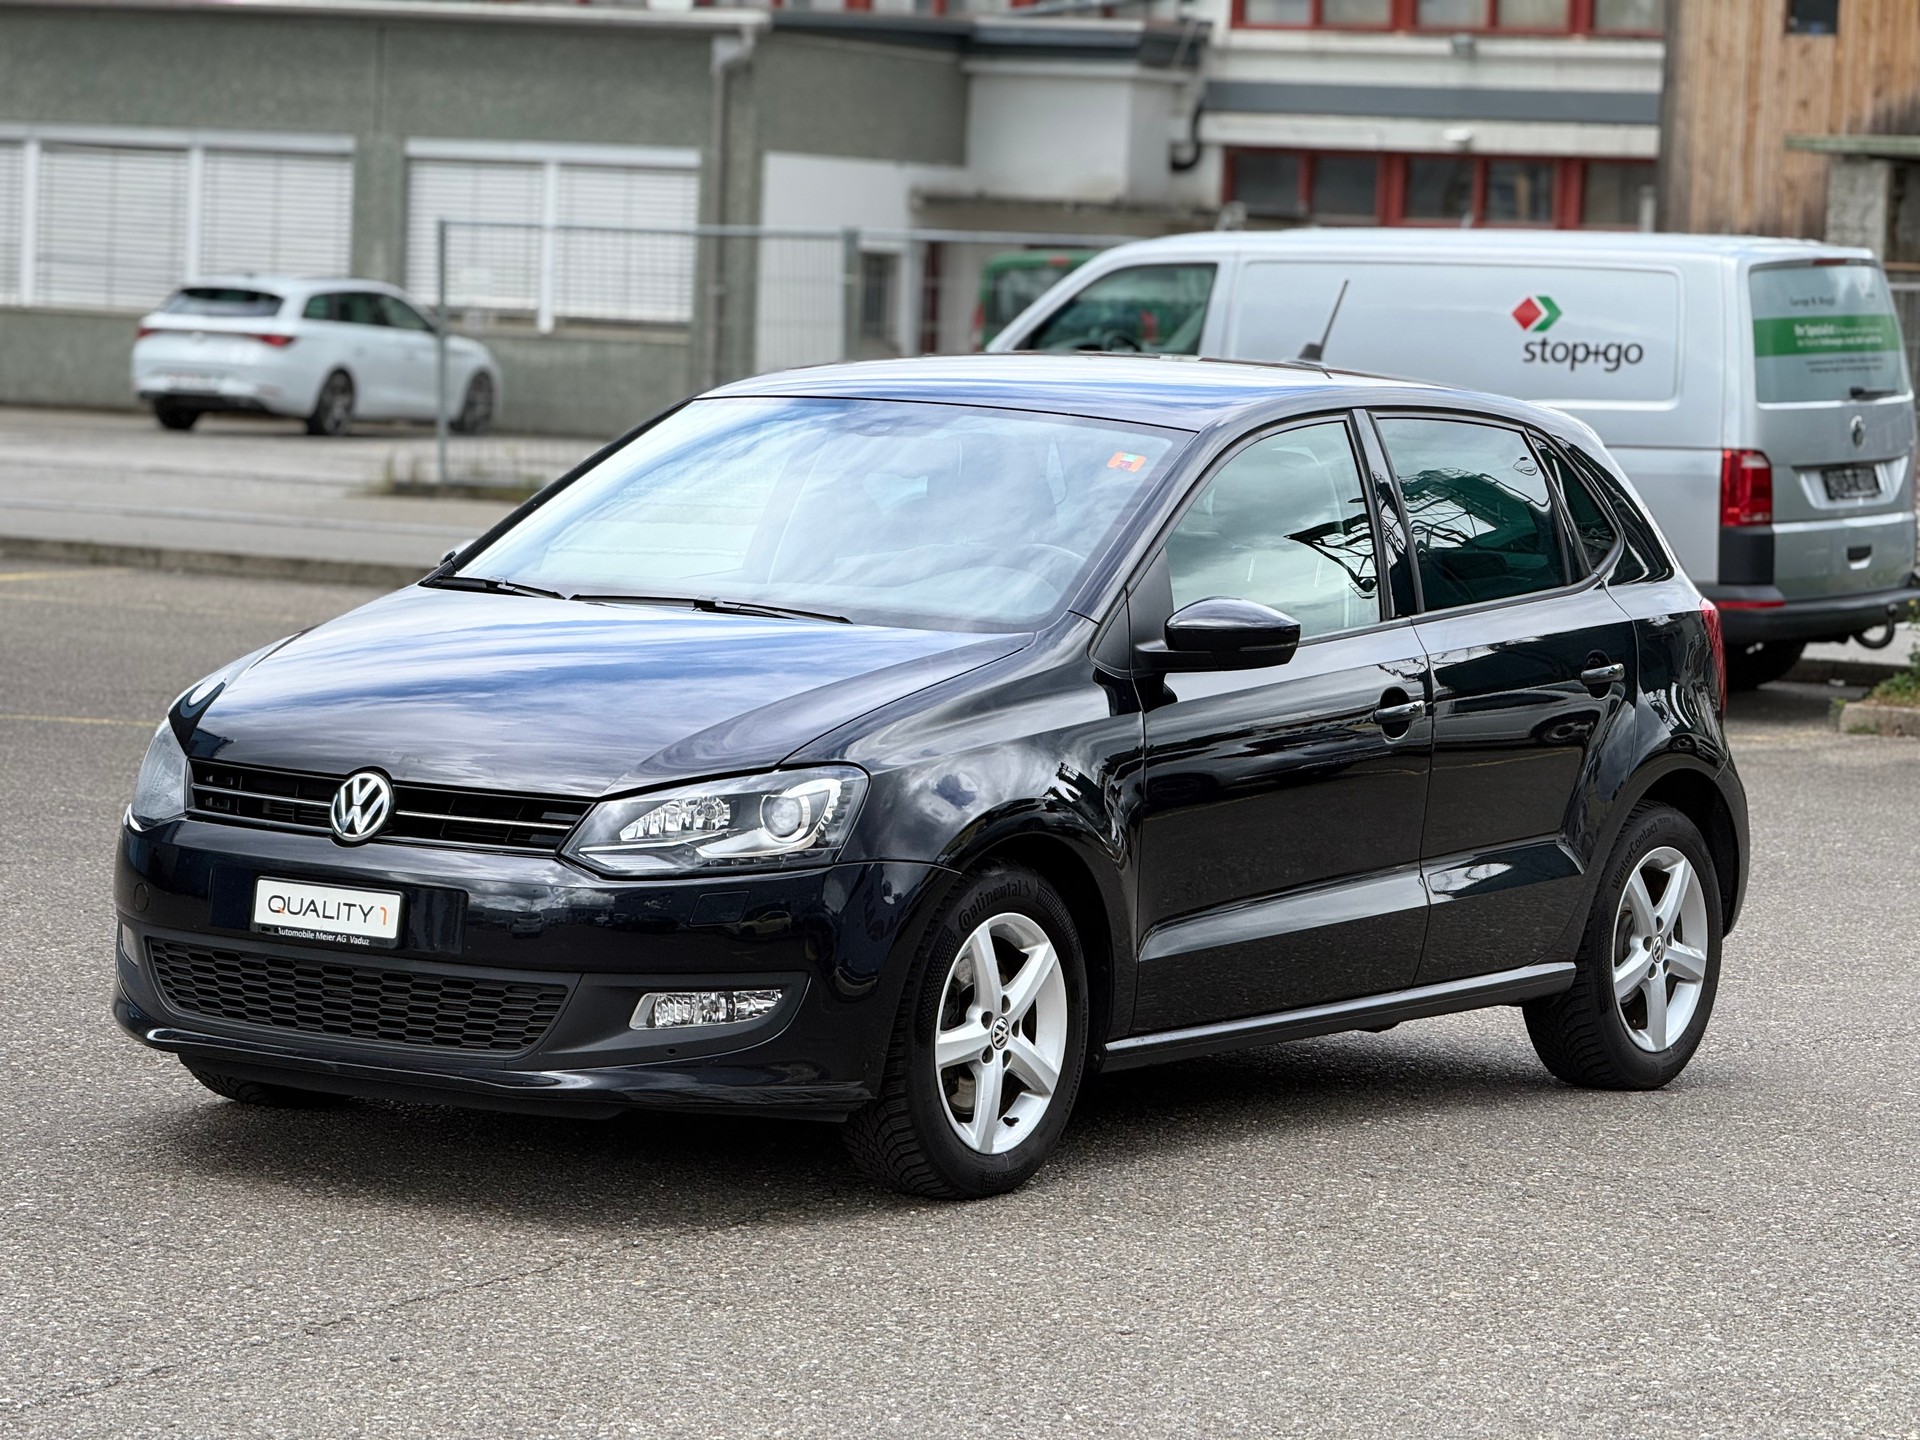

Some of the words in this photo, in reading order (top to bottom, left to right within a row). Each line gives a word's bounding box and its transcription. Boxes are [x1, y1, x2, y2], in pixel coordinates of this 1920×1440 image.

[1523, 337, 1643, 373] stop+go
[268, 895, 375, 923] QUALITY
[958, 879, 1022, 932] Continental
[315, 932, 335, 942] Meier
[336, 934, 347, 943] AG
[350, 936, 370, 946] Vaduz
